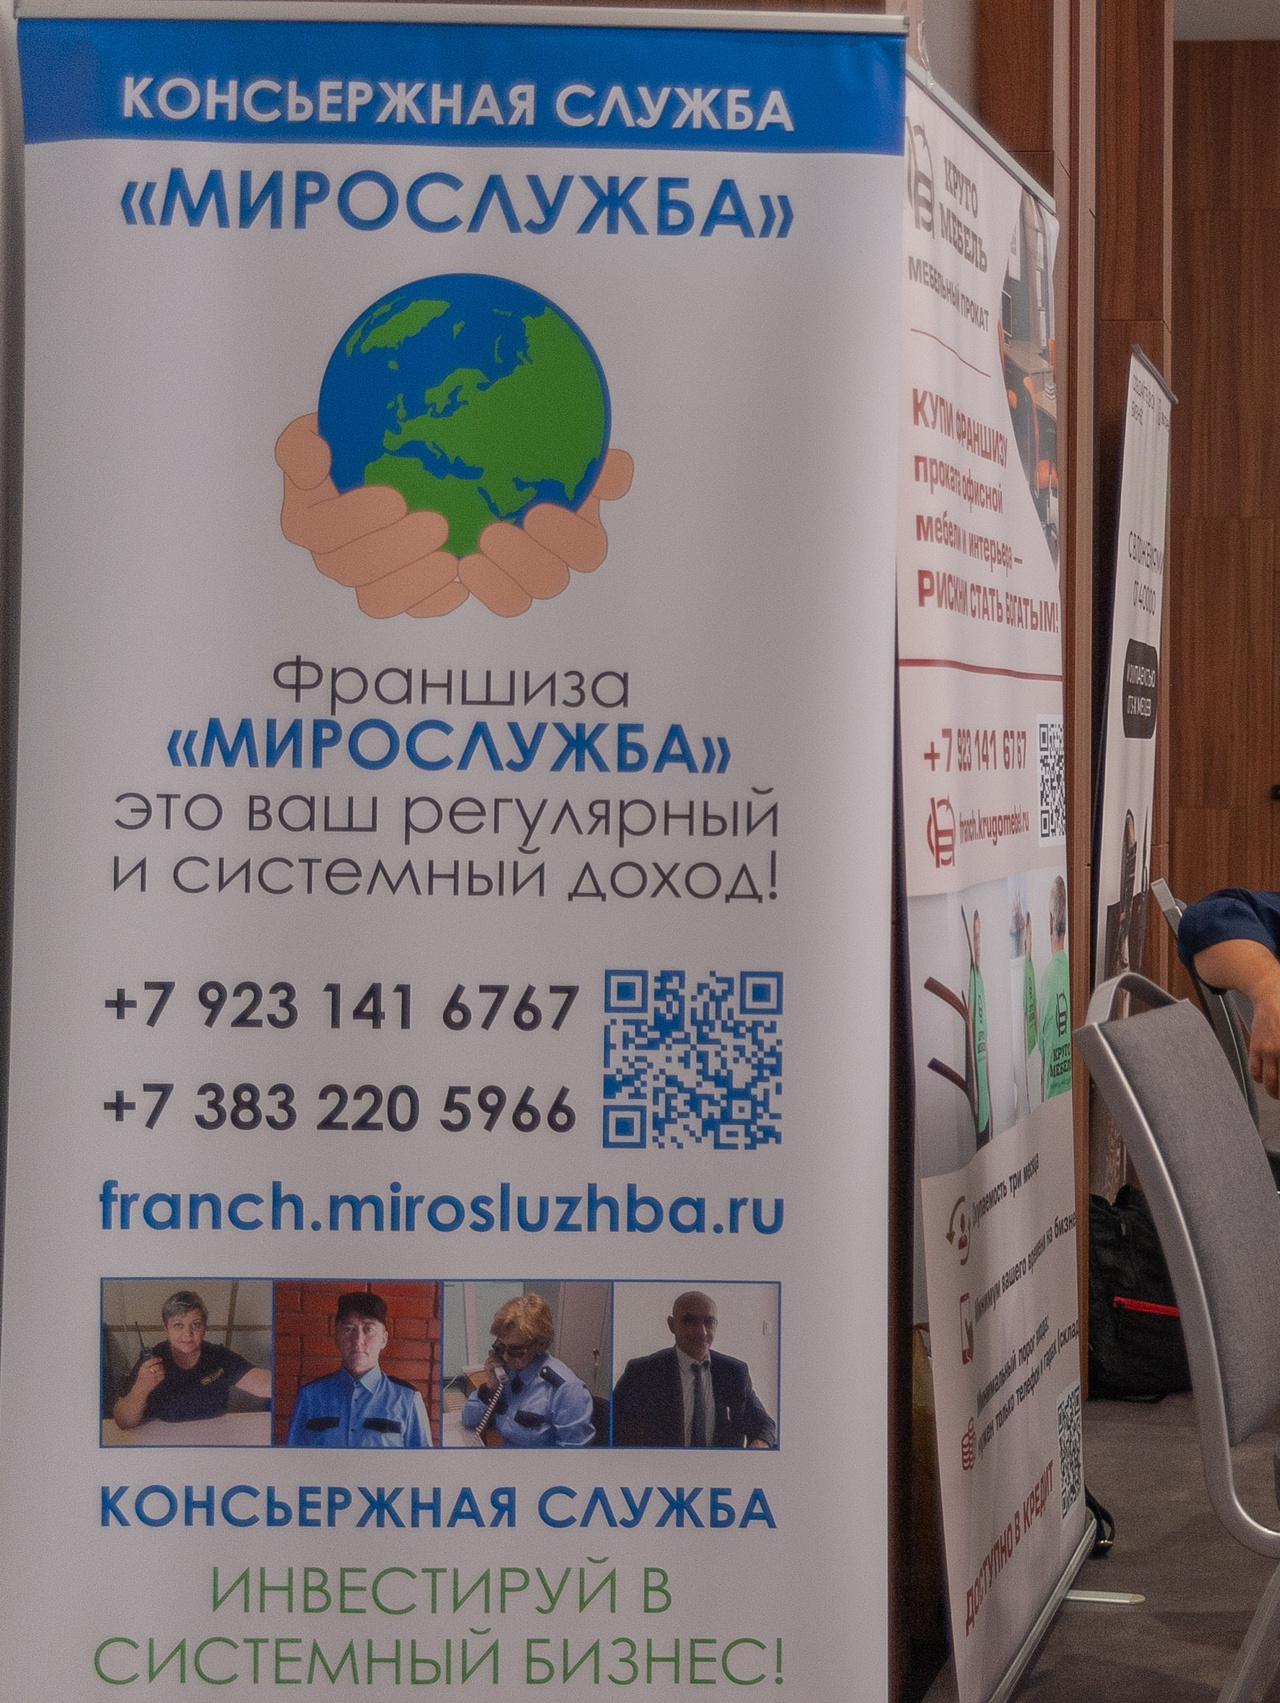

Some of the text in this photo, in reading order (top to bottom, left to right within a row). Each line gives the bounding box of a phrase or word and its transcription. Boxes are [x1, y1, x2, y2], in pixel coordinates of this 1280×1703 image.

[122, 76, 796, 133] КОНСЬЕРЖНАЯ СЛУЖБА
[120, 167, 795, 240] «МИРОСЛУЖБА»
[943, 155, 979, 219] КРУГО
[939, 202, 988, 274] МЕБЕЛЬ
[961, 293, 990, 332] ПРОКАТ
[912, 388, 1008, 469] КУПИ ФРАНШИЗУ
[969, 582, 1004, 623] СТАТЬ
[1005, 592, 1059, 633] БОГАТЫМ!
[273, 655, 630, 716] Франшиза
[167, 717, 733, 775] «МИРОСЛУЖБА»
[924, 728, 953, 773] +7
[974, 729, 997, 771] 141
[115, 787, 780, 847] это ваш регулярный
[113, 848, 779, 902] и системный доход!
[104, 981, 581, 1033] +7 923 141 6767
[103, 1083, 577, 1134] +7 383 220 5966
[99, 1180, 785, 1235] franch.mirosluzhba.ru
[1008, 1169, 1022, 1198] три
[1001, 1257, 1027, 1294] вашего
[100, 1485, 778, 1530] КОНСЬЕРЖНАЯ СЛУЖБА
[965, 1459, 1054, 1638] ДОСТУПНО В КРЕДИТ
[212, 1556, 673, 1615] ИНВЕСТИРУЙ В
[94, 1628, 785, 1687] СИСТЕМНЫЙ БИЗНЕС!
